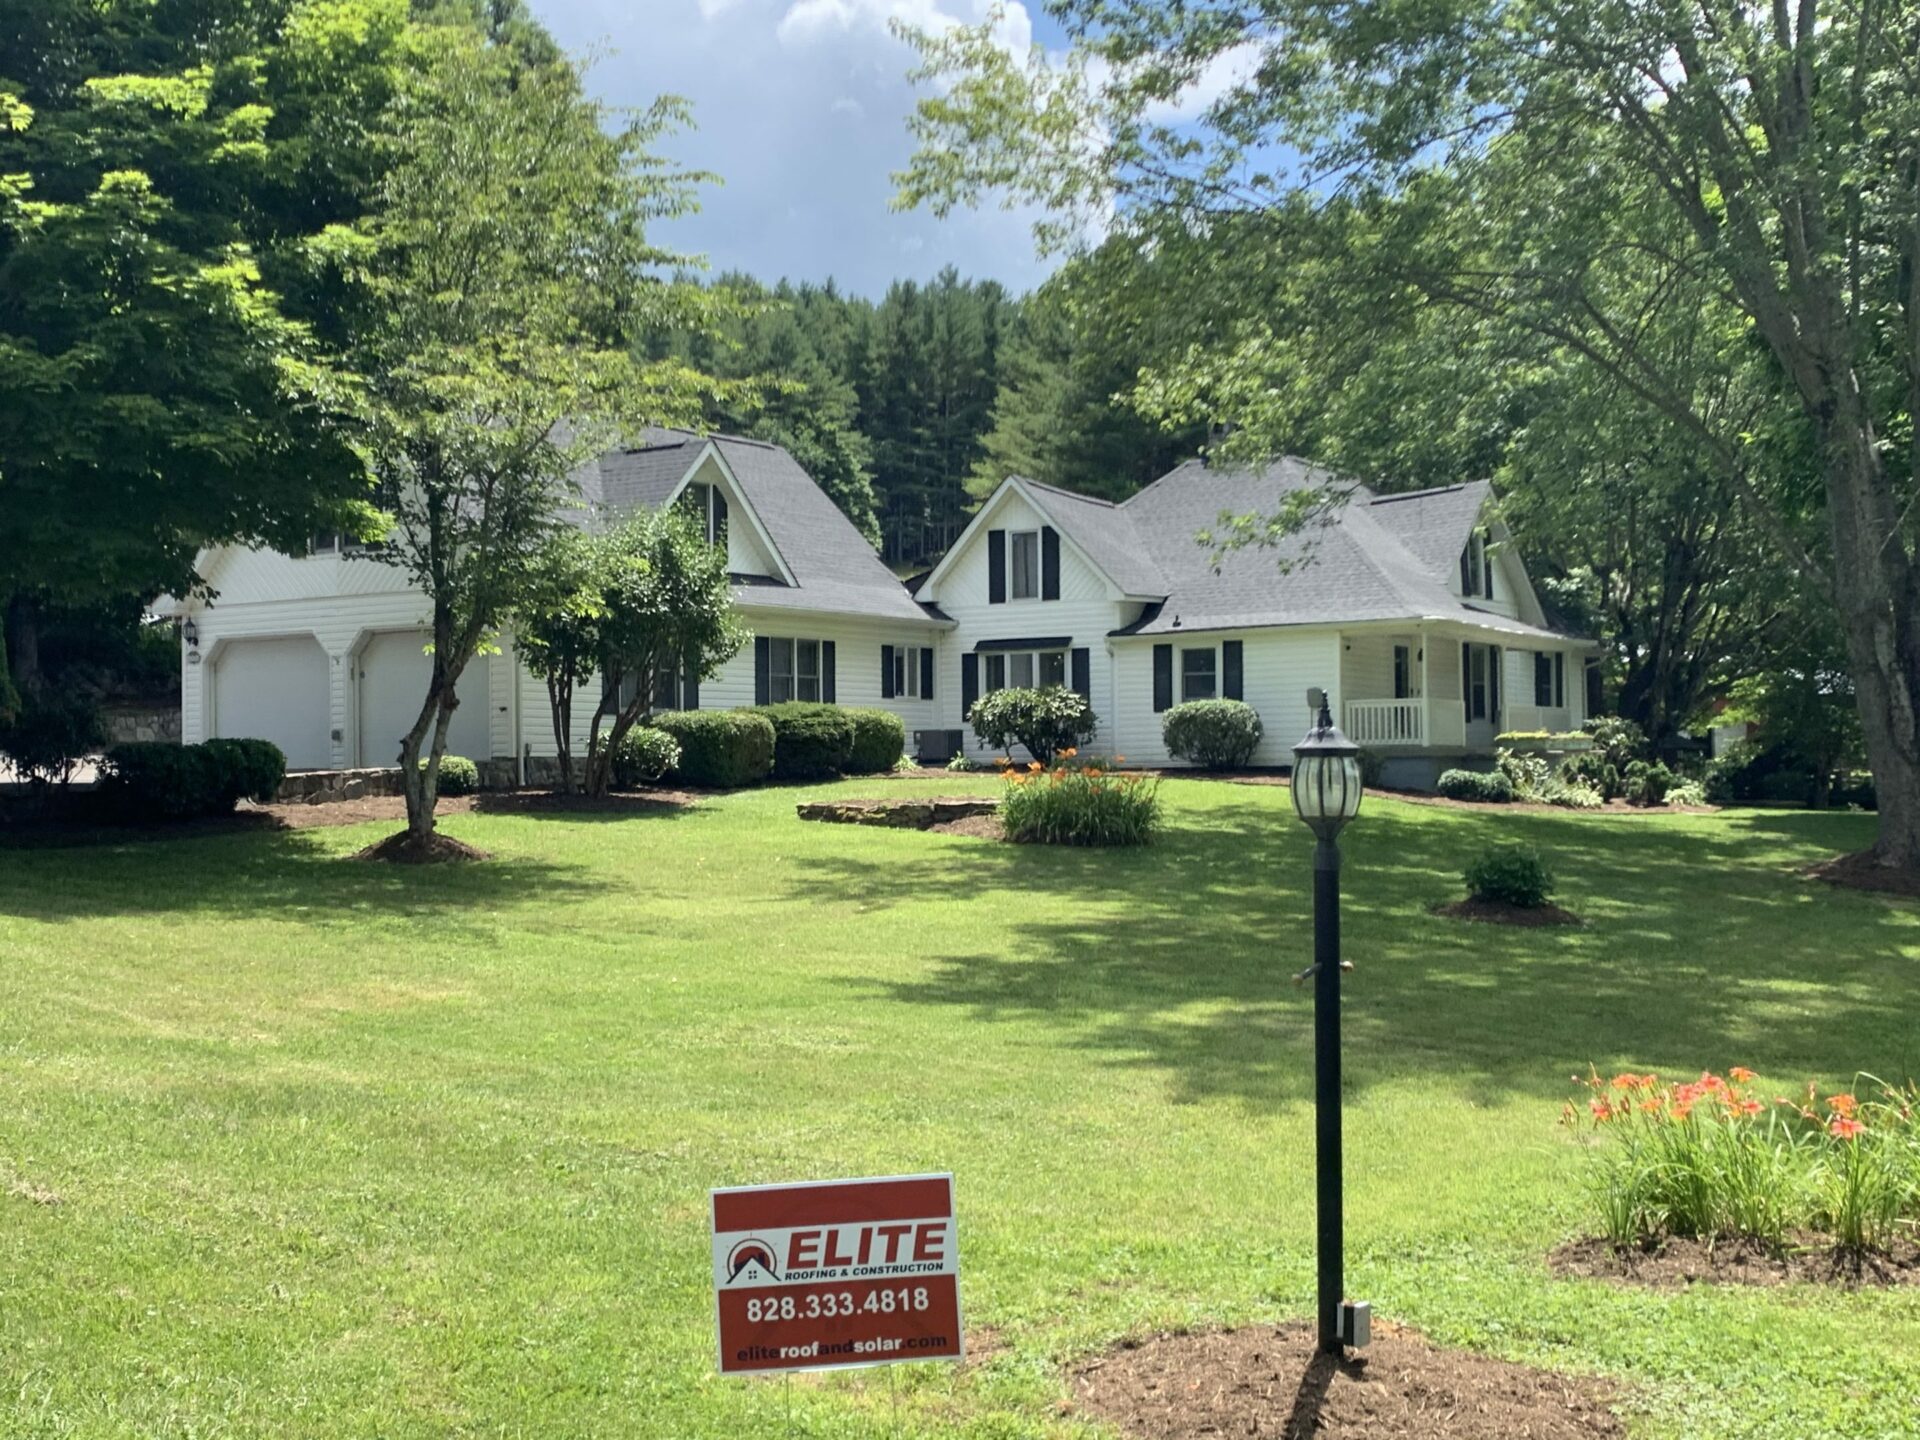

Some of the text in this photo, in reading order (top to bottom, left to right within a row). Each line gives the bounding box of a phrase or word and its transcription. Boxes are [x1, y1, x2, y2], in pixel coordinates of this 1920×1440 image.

[786, 1222, 947, 1270] ELITE
[785, 1262, 944, 1281] ROOFING & CONSTRUCTION
[747, 1287, 929, 1322] 828.333.4818
[737, 1334, 948, 1361] eliteroofandsolar.com
